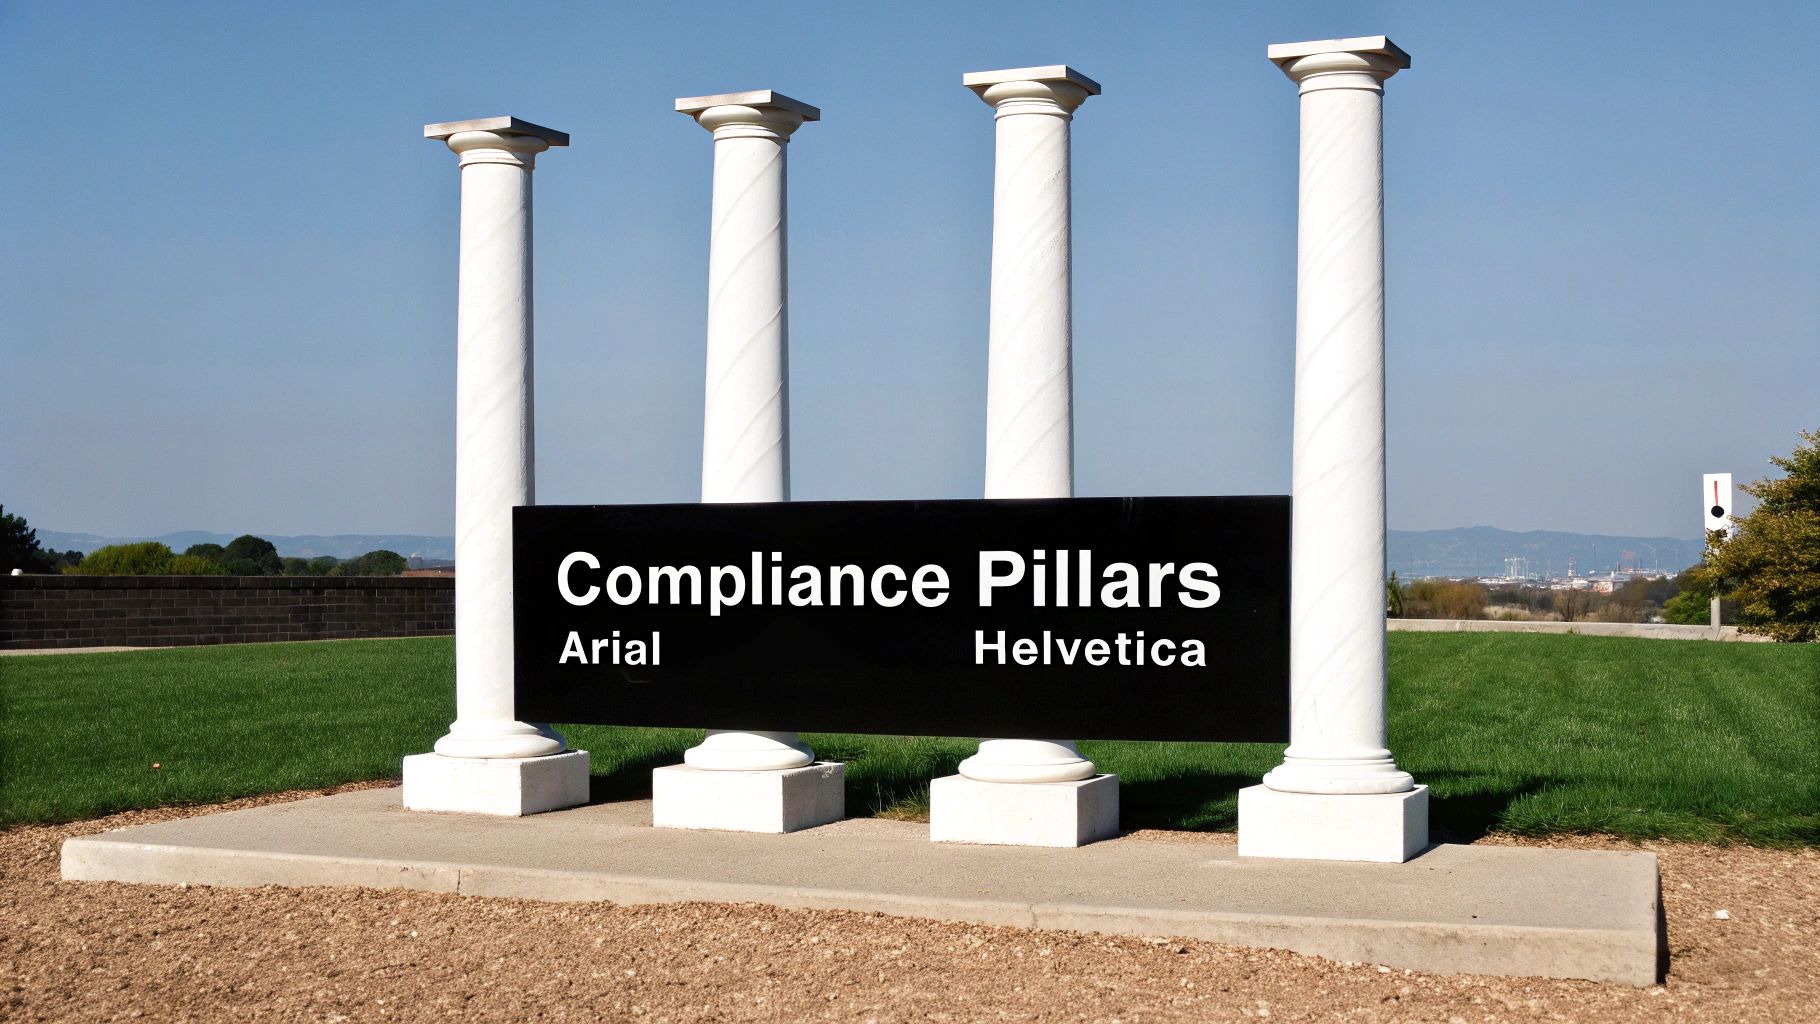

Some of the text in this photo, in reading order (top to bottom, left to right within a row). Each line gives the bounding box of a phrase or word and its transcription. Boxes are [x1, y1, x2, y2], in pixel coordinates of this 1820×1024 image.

[557, 549, 1221, 617] Compliance Pillars
[558, 630, 661, 666] Arial
[975, 629, 1207, 667] Helvetica
